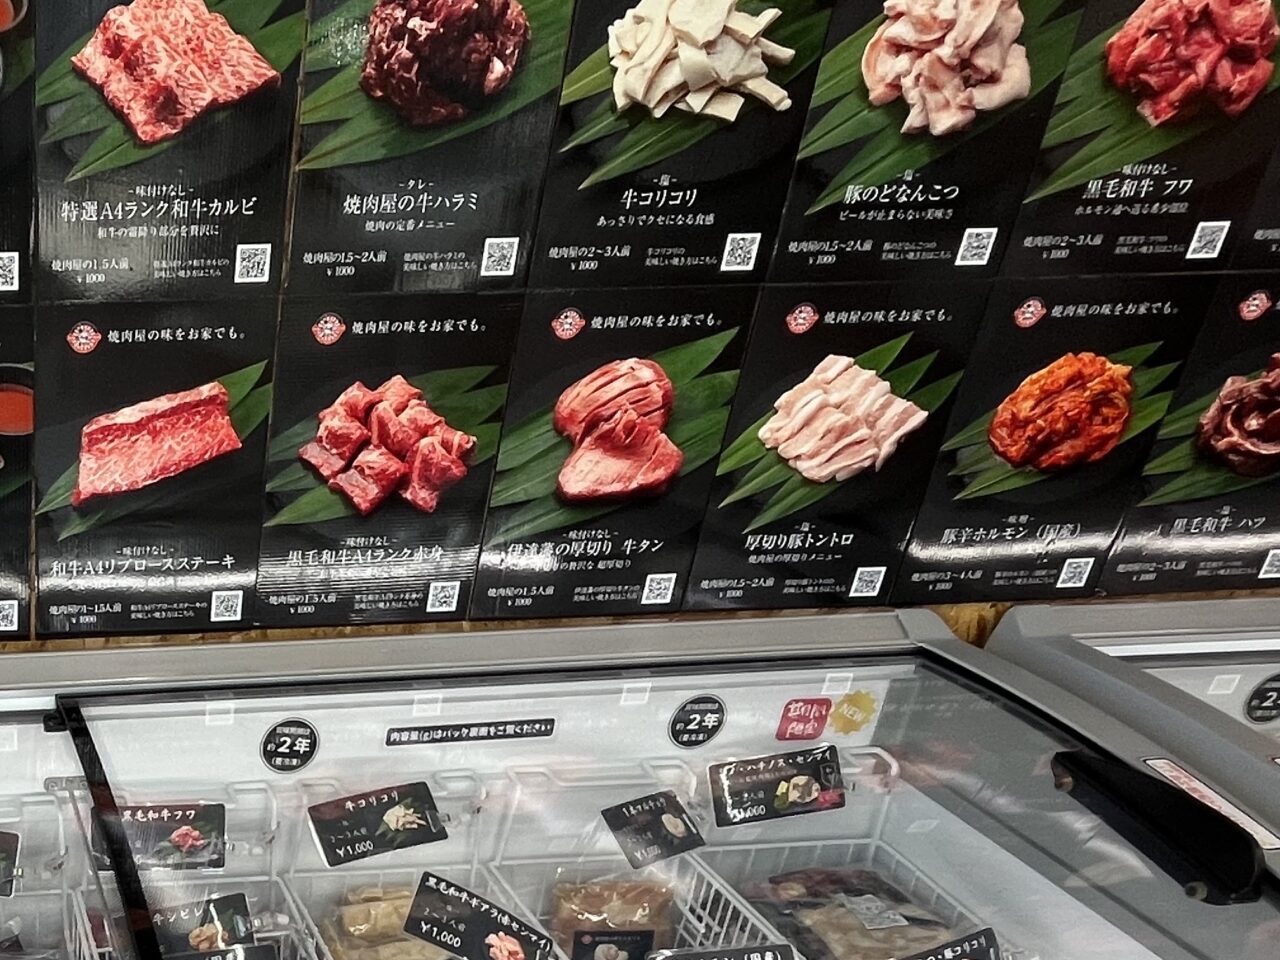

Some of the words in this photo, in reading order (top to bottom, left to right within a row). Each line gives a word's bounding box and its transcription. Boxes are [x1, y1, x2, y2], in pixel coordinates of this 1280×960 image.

[843, 184, 959, 205] 豚のどなんこつ
[1081, 178, 1154, 199] 黒毛和牛
[1162, 178, 1193, 196] フワ
[343, 191, 479, 215] 焼肉屋の牛ハラミ
[620, 188, 698, 210] 牛コリコリ
[61, 196, 257, 223] 特選A4ランク和牛カルビ
[365, 219, 455, 232] 焼肉の定番メニュー
[597, 213, 715, 227] あっさりでクセになる食感
[590, 313, 722, 330] 焼肉屋の味をお家でも。
[823, 309, 953, 324] 焼肉屋の味をお家でも。
[107, 327, 246, 344] 焼肉屋の味をお家でも。
[351, 318, 487, 335] 焼肉屋の味をお家でも。
[621, 538, 664, 555] 牛タン
[744, 533, 854, 551] 厚切り豚トントロ
[49, 554, 237, 577] 和牛A4リブロースステーキ
[838, 703, 866, 722] NEW
[344, 790, 400, 812] 牛コリコリ
